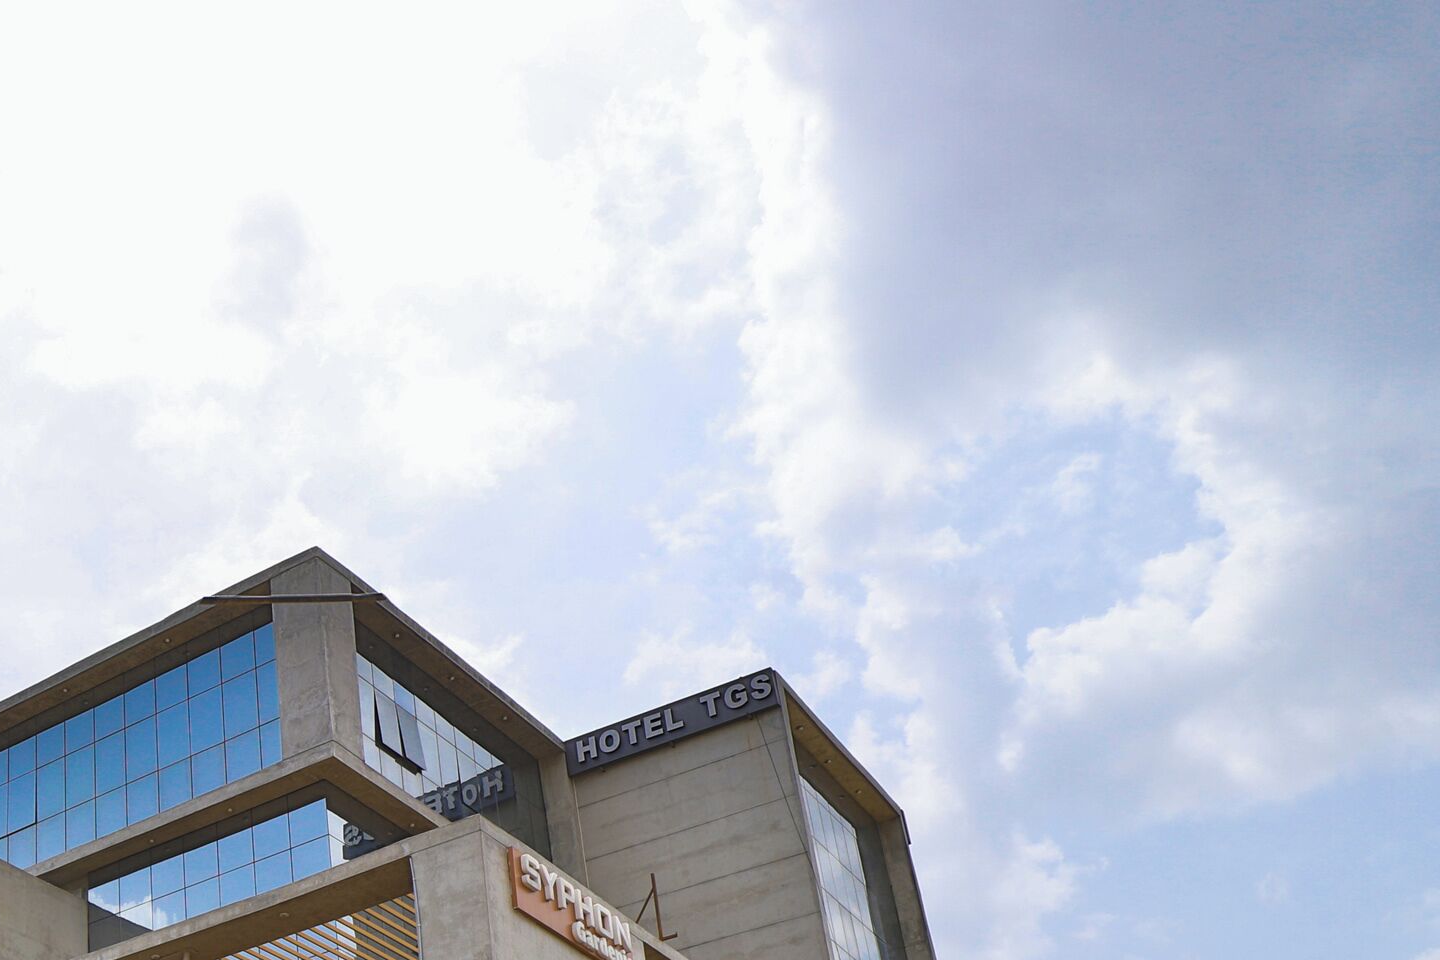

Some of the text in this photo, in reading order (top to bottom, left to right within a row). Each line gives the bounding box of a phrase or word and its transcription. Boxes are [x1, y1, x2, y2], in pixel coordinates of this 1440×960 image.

[576, 674, 772, 763] HOTEL TGS
[521, 853, 632, 953] SYPHON
